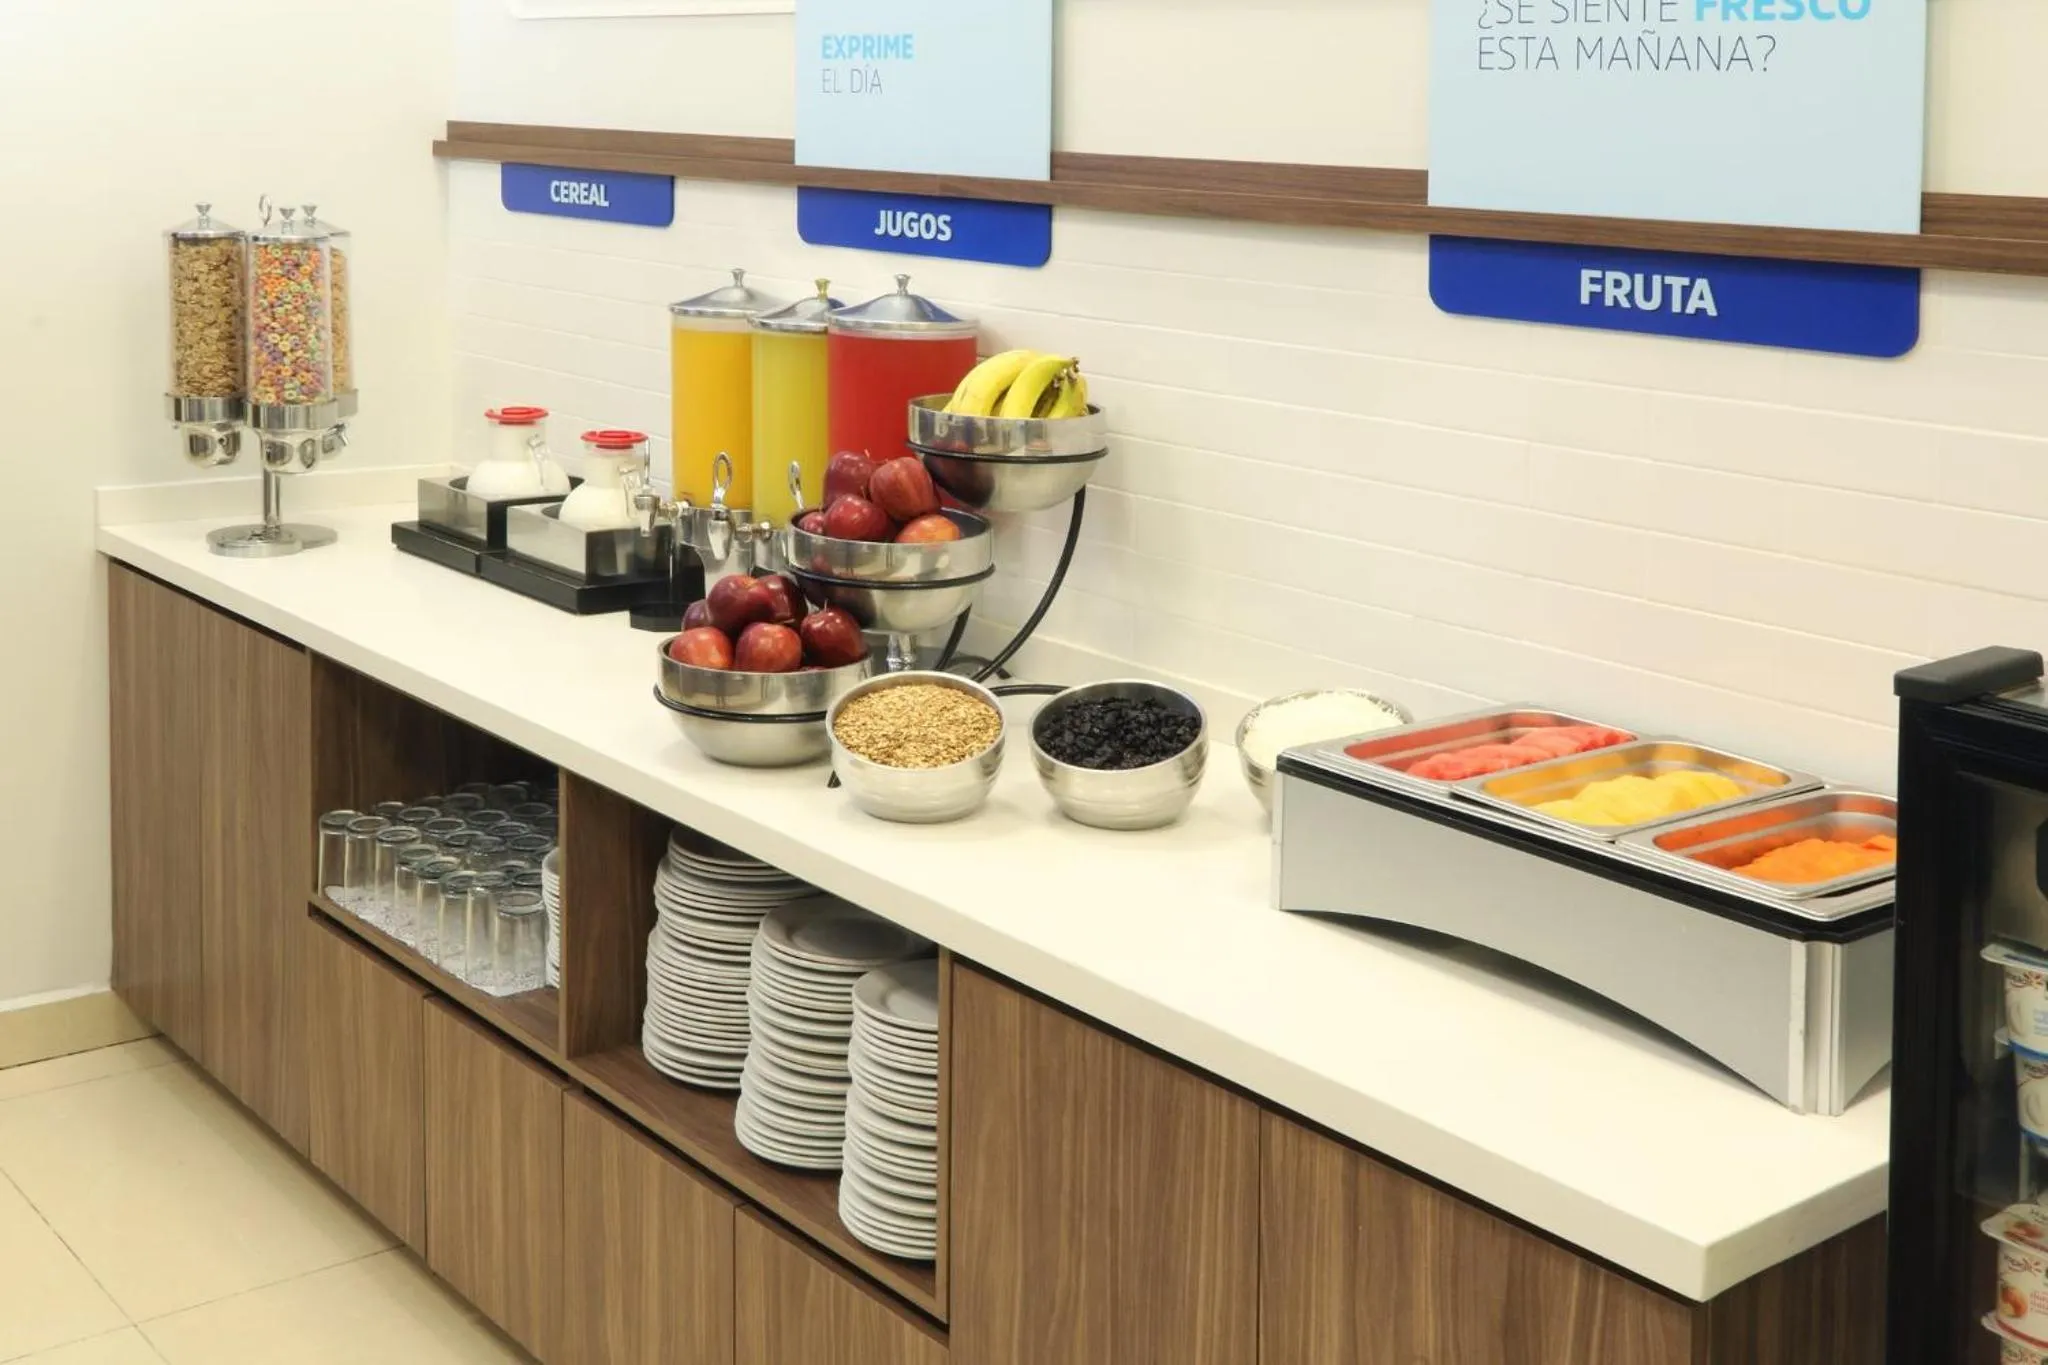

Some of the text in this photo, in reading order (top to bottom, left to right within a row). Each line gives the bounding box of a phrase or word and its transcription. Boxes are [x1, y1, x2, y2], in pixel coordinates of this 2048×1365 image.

[1478, 0, 1871, 30] ¿SE SIENTE FRESCO
[821, 35, 914, 60] EXPRIME
[1479, 29, 1777, 72] ESTA MAÑANA?
[822, 63, 883, 94] EL DÍA
[550, 180, 610, 207] CEREAL
[874, 209, 953, 242] JUGOS
[1580, 268, 1719, 317] FRUTA
